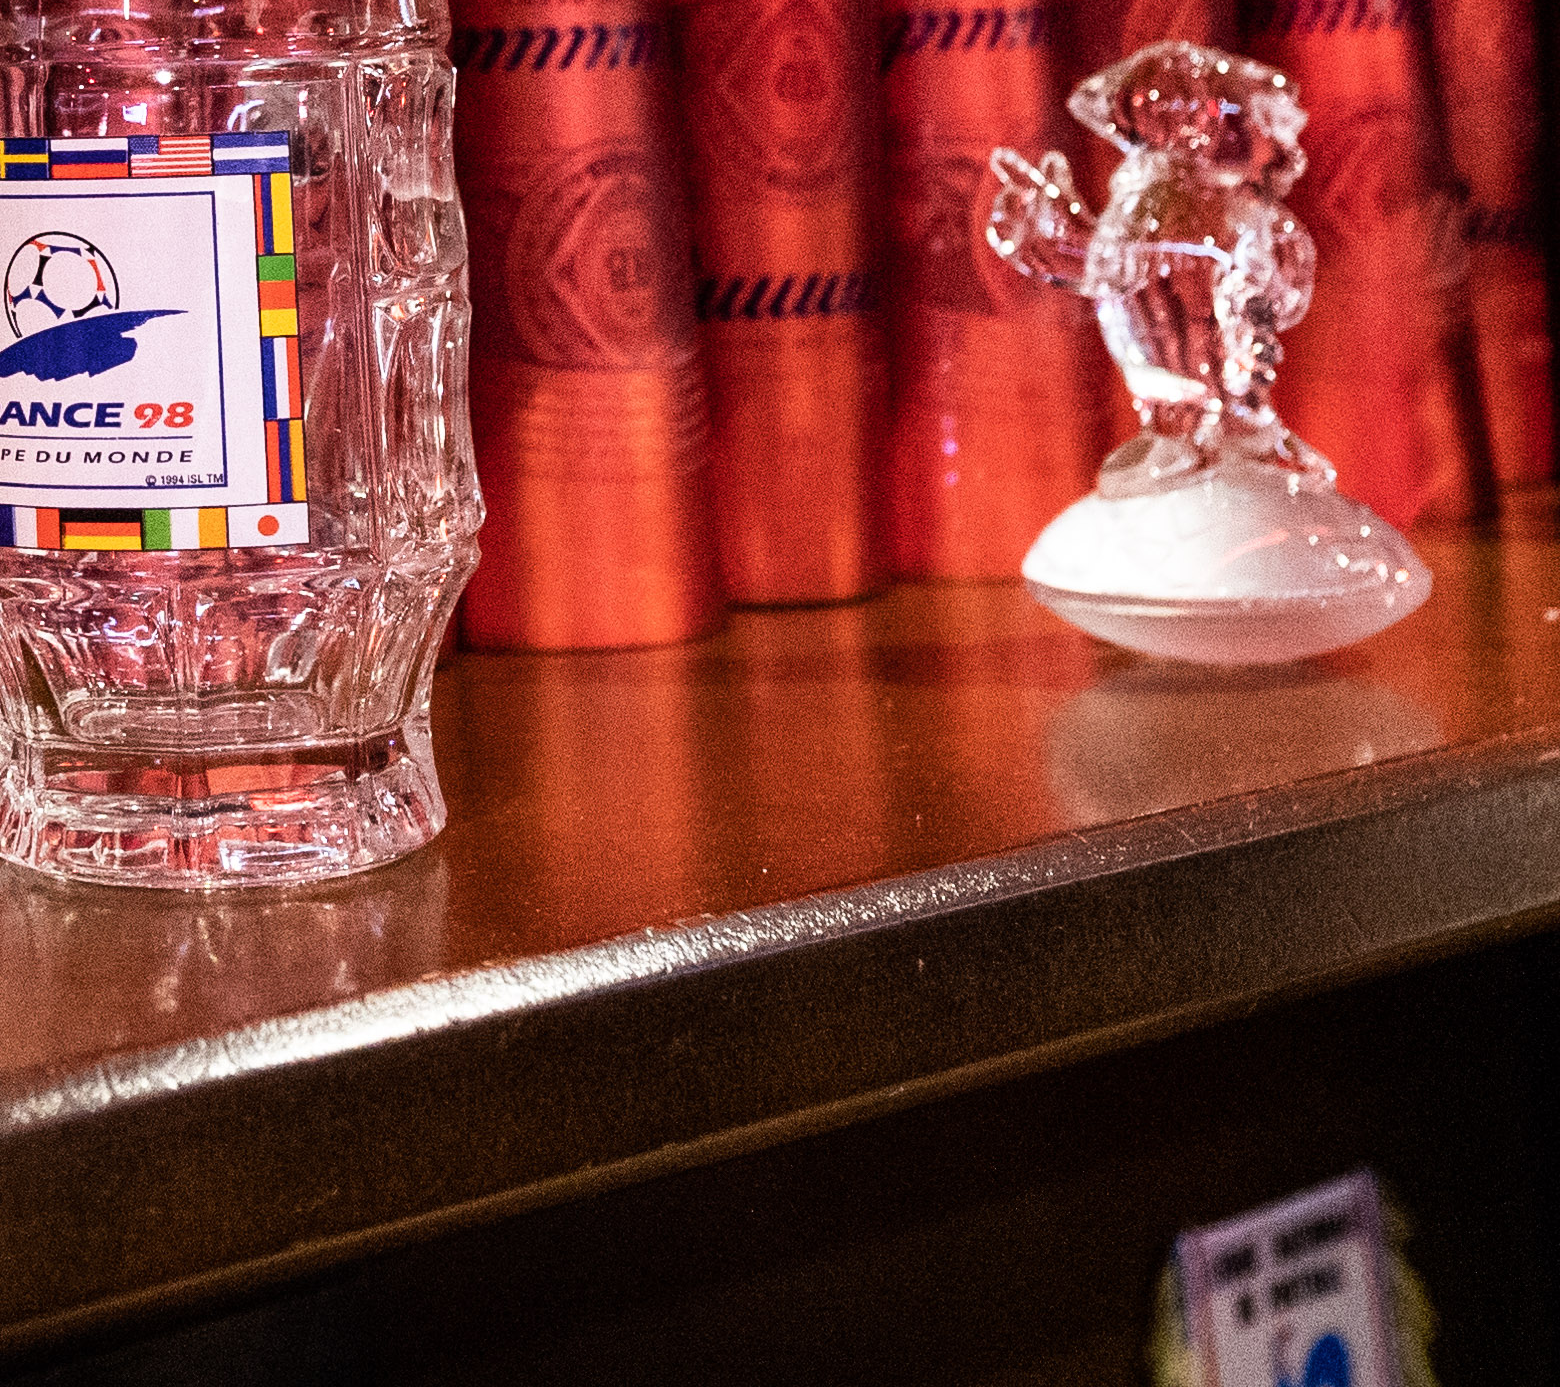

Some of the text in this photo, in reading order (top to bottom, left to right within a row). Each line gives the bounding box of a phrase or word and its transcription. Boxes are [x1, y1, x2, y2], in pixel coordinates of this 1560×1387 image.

[134, 401, 194, 429] 98
[36, 450, 71, 463] DU
[83, 450, 193, 463] MONDE
[161, 473, 224, 485] 1994 ISL TM
